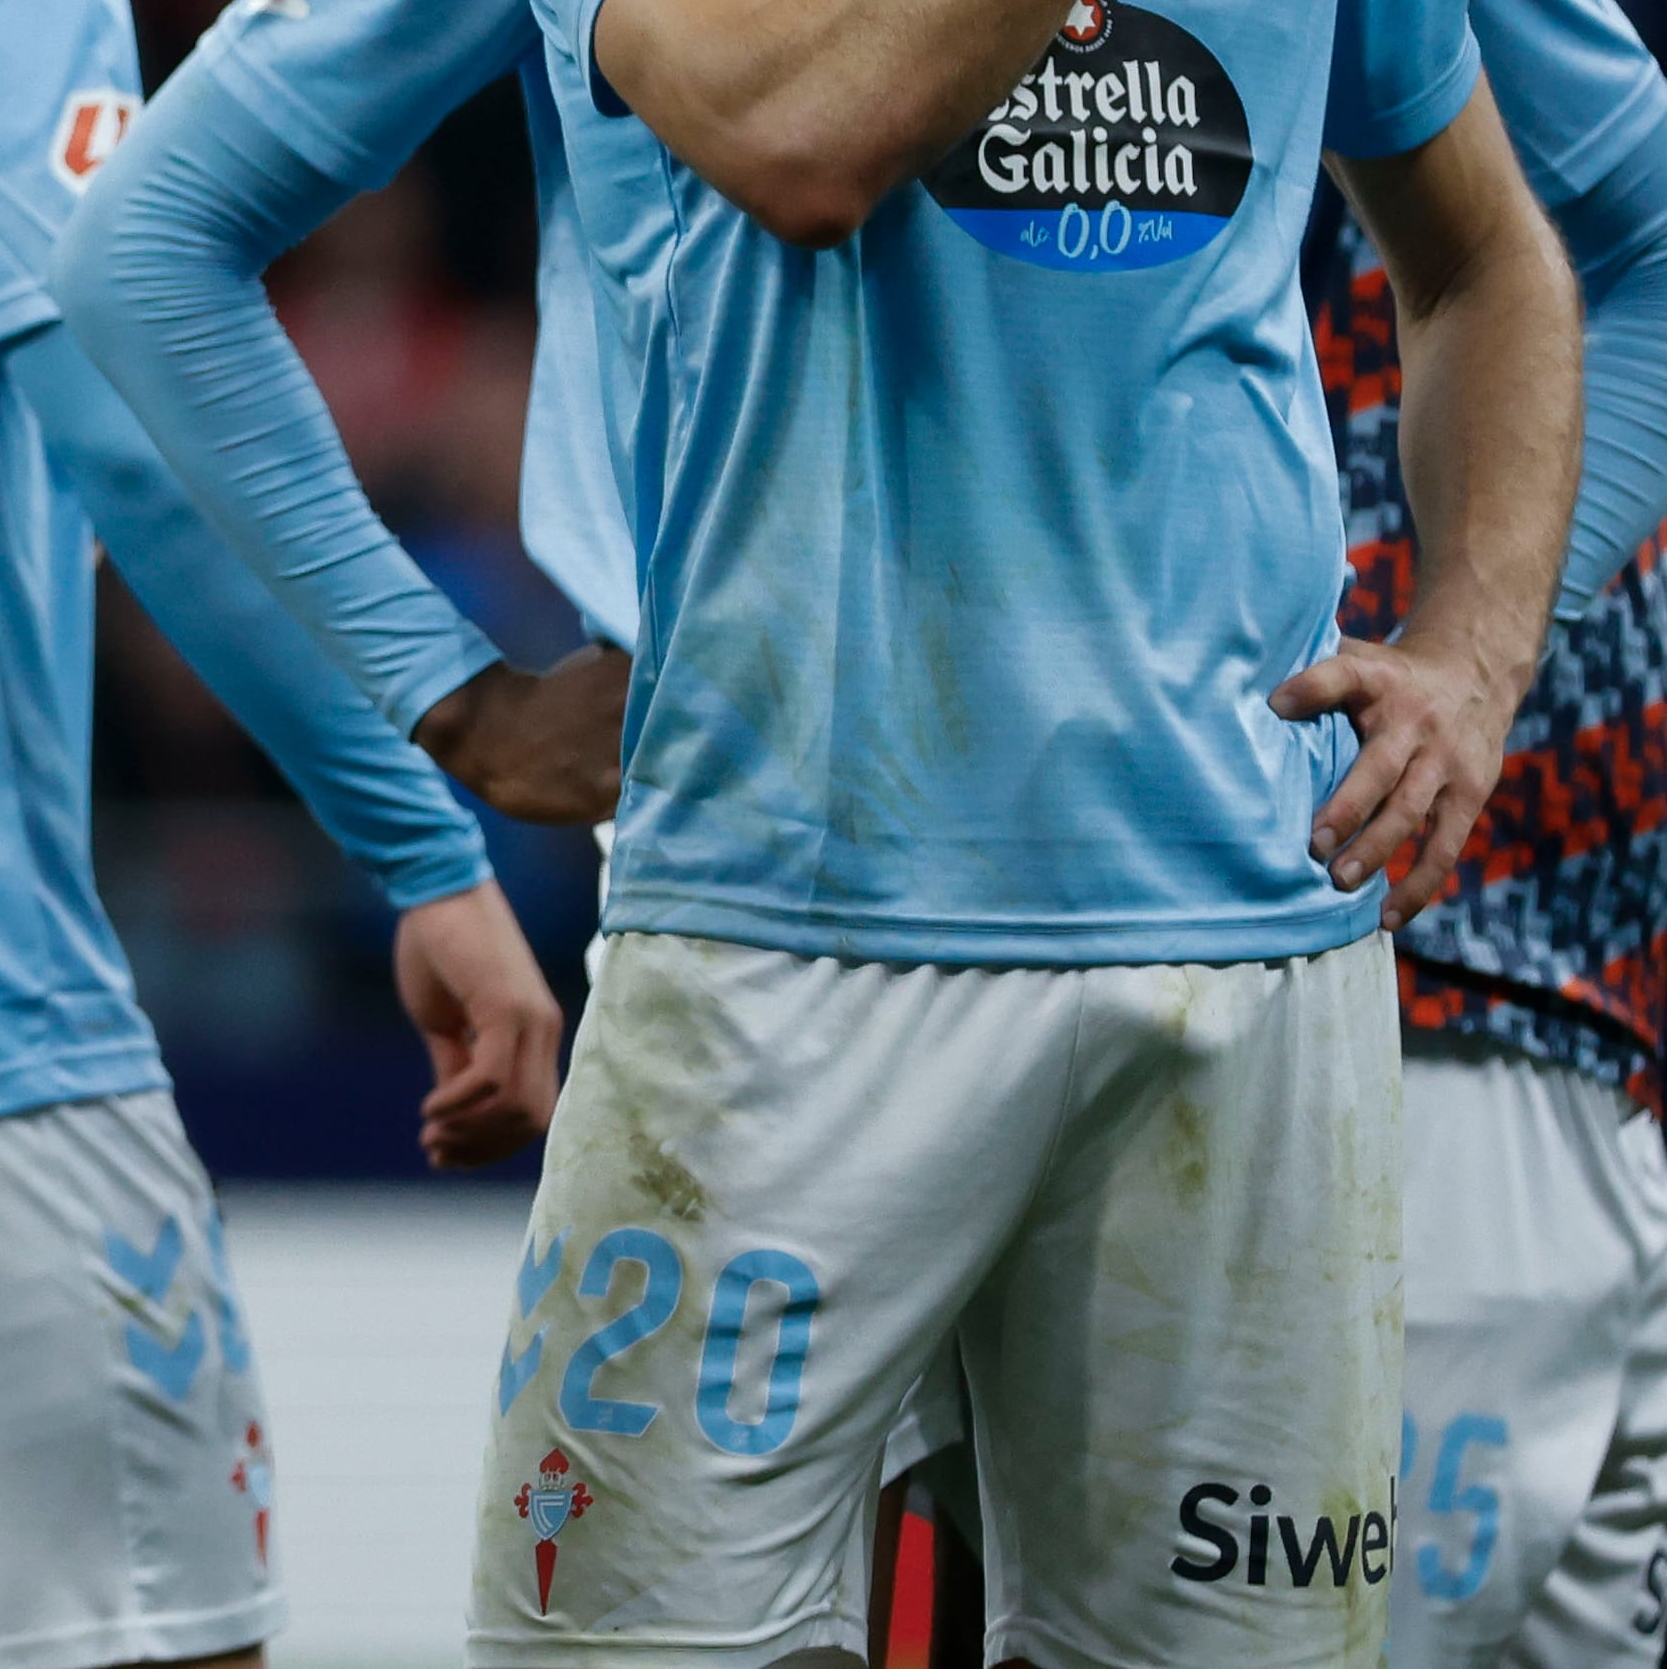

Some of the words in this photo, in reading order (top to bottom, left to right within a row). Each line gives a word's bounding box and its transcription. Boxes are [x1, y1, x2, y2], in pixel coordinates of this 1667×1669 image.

[987, 55, 1201, 128] strella
[978, 123, 1198, 196] Galicia
[1057, 200, 1132, 260] 0,0
[558, 1225, 820, 1455] 20
